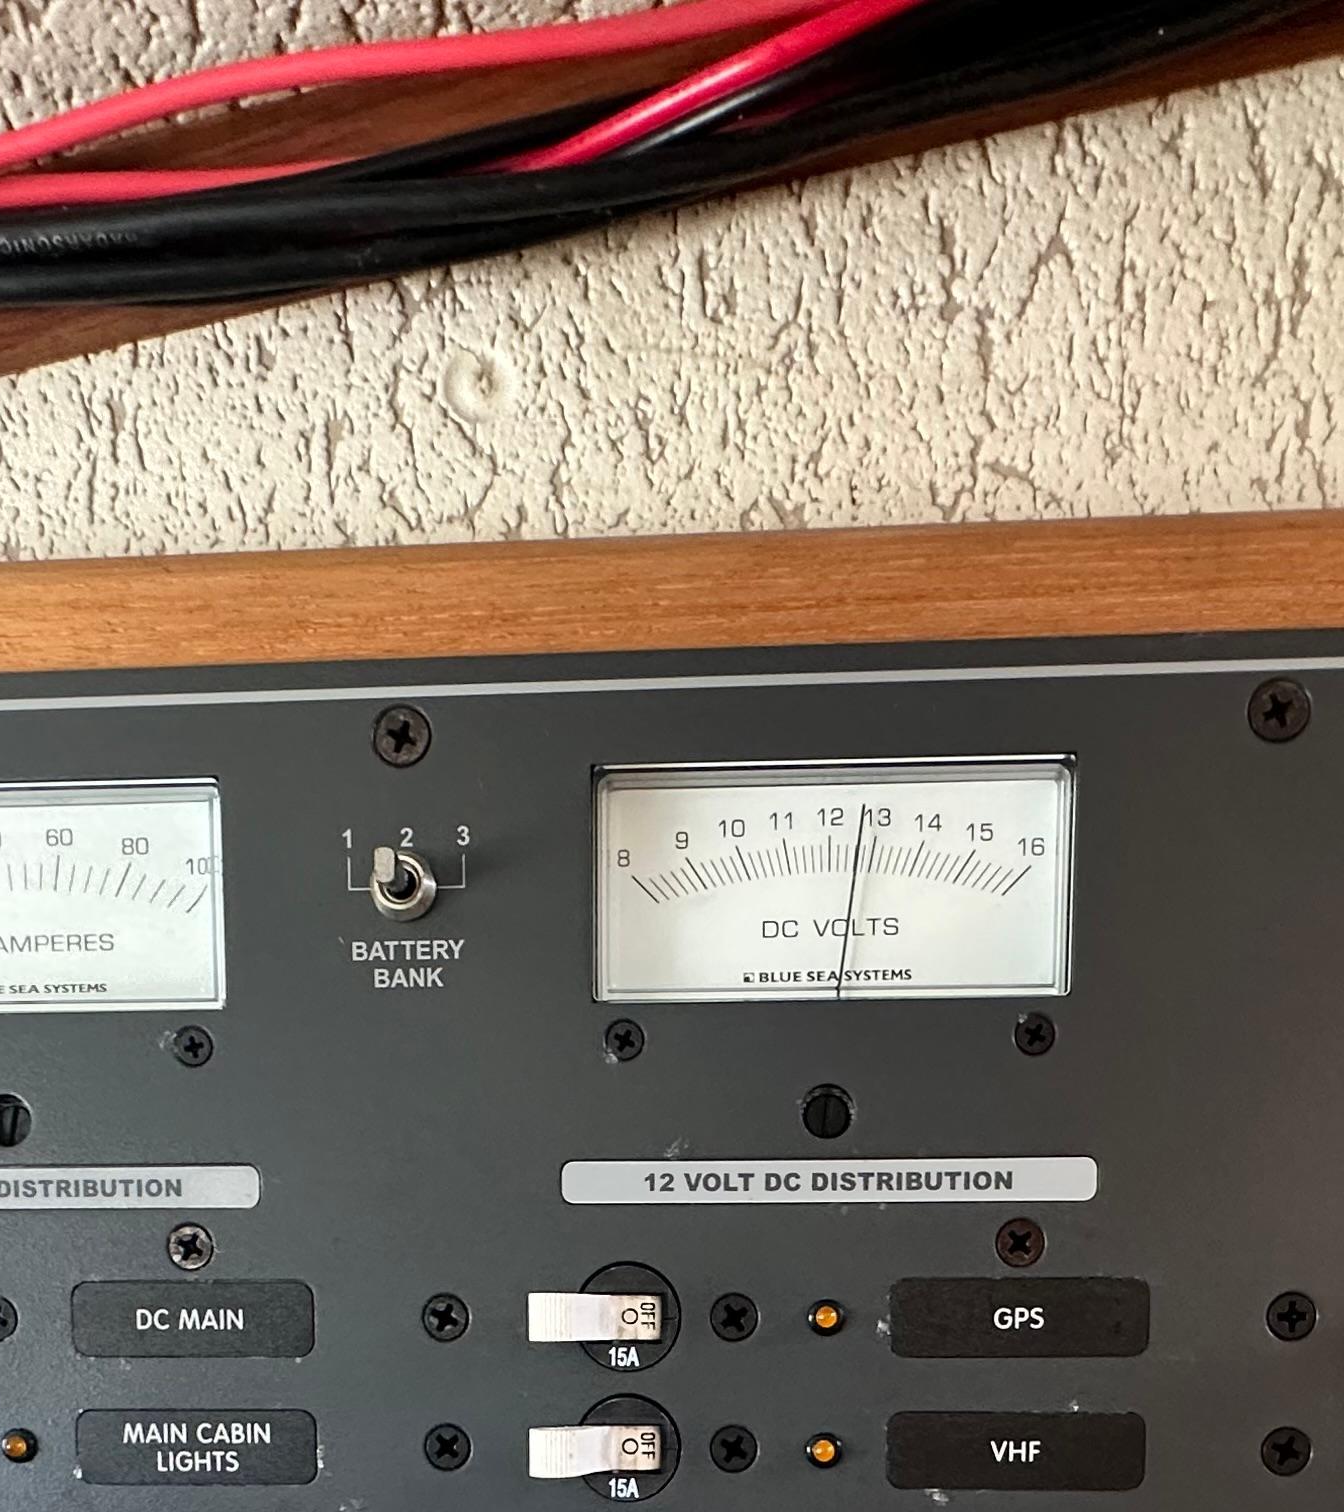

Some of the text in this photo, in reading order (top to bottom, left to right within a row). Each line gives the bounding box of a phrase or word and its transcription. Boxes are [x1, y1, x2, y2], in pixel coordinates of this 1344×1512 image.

[769, 812, 794, 830] 11
[817, 808, 844, 826] 12
[865, 809, 891, 826] 13
[915, 814, 942, 832] 14
[46, 829, 72, 846] 60
[400, 827, 414, 847] 2
[457, 826, 470, 845] 3
[719, 819, 745, 837] 10
[966, 824, 994, 841] 15
[122, 838, 149, 855] 80
[342, 829, 351, 848] 1
[676, 832, 688, 849] 9
[1017, 838, 1045, 856] 16
[618, 850, 630, 867] 8
[762, 917, 899, 938] DC VOLTS
[352, 940, 464, 961] BATTERY
[374, 968, 444, 988] BANK
[759, 969, 912, 982] BLUE SEA SYSTEMS
[10, 984, 39, 994] SEA
[44, 983, 107, 994] SYSTEMS
[644, 1172, 1013, 1192] 12 VOLT DC DISTRIBUTION
[136, 1309, 244, 1331] DC MAIN
[640, 1303, 655, 1330] OFF
[993, 1308, 1045, 1330] GPS
[608, 1347, 639, 1367] 15A
[122, 1422, 271, 1446] MAIN CABIN
[640, 1432, 655, 1459] OFF
[990, 1441, 1040, 1462] VHF
[157, 1450, 240, 1473] LIGHTS
[608, 1478, 639, 1498] 15A
